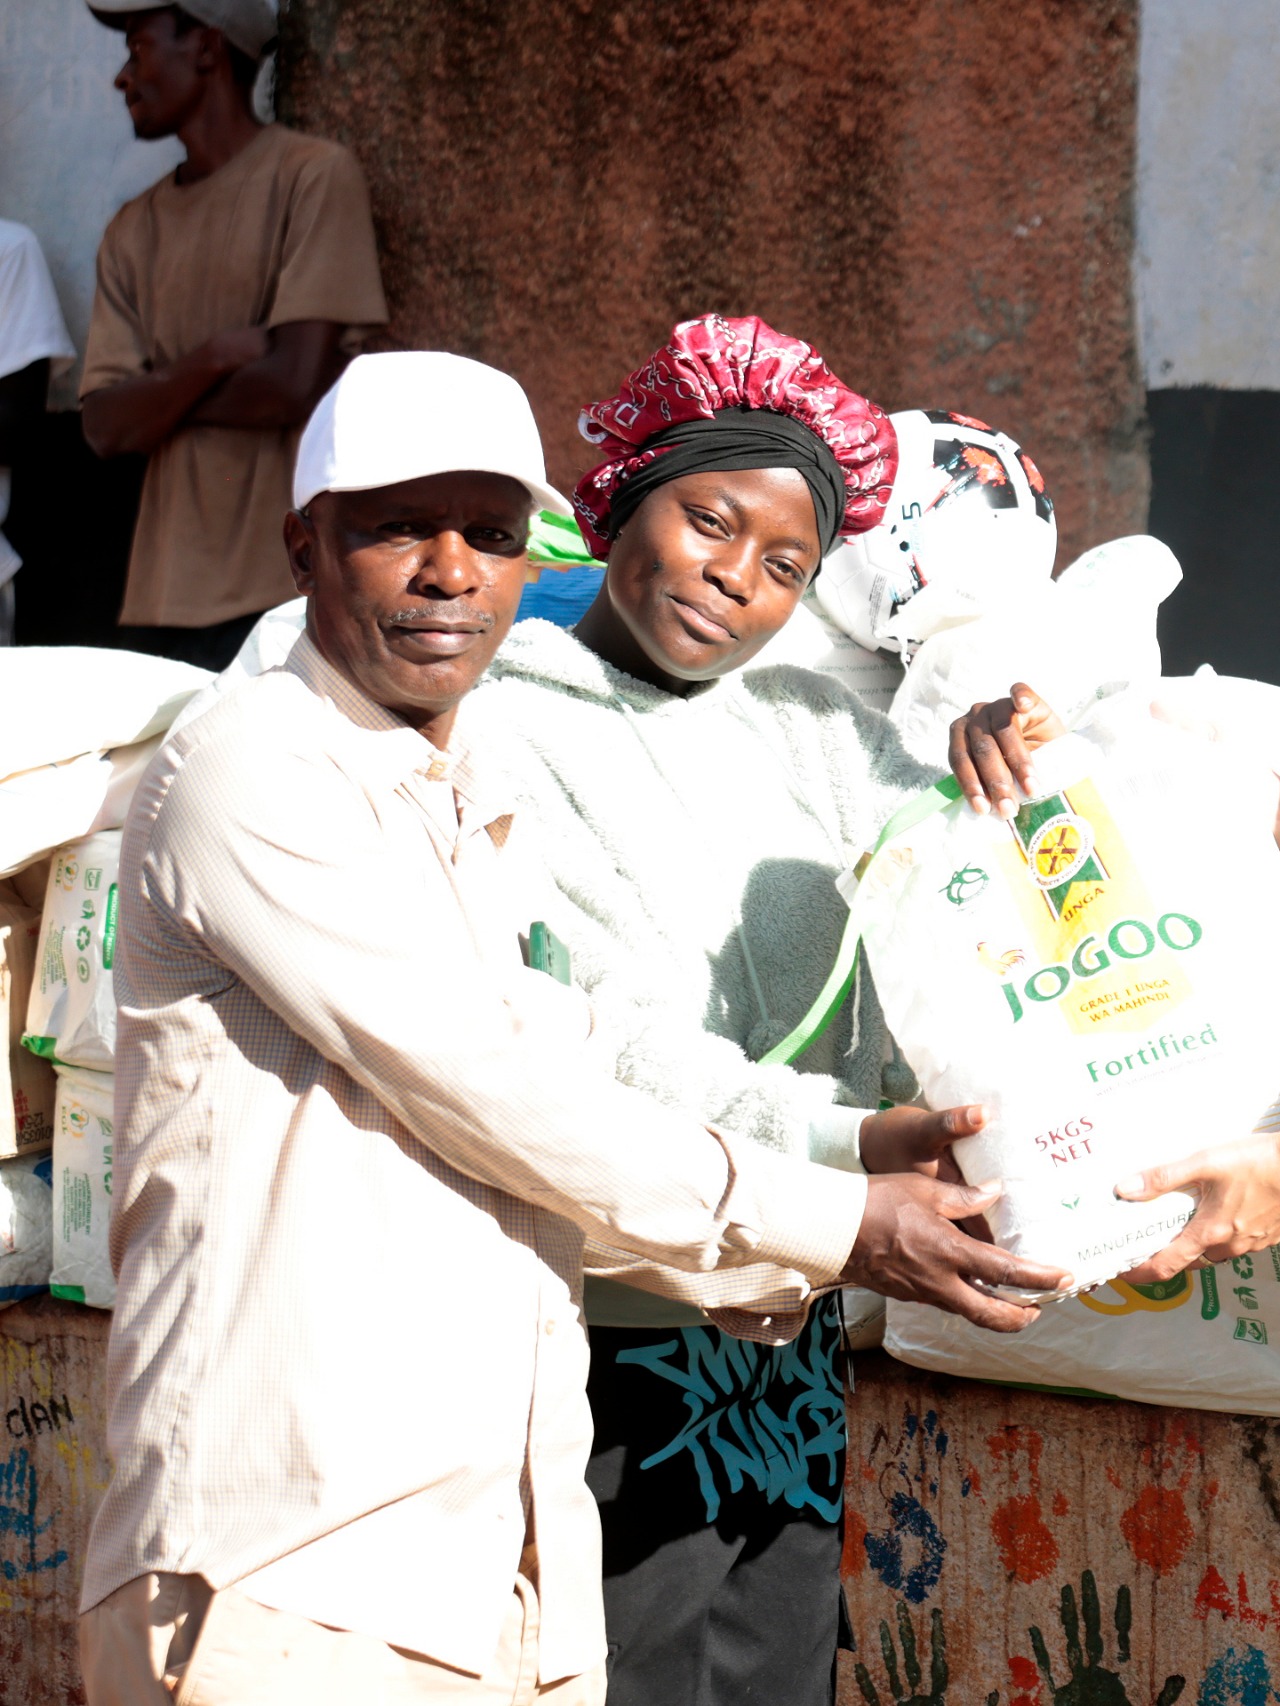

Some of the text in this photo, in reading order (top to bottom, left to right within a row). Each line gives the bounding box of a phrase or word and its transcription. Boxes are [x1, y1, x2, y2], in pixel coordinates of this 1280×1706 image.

[1063, 886, 1105, 923] UNGA
[1001, 912, 1203, 1024] JOGOO
[1080, 990, 1121, 1013] GRADE
[1135, 978, 1171, 994] UNGA
[1089, 991, 1171, 1024] WA MAHINDI
[1086, 1022, 1218, 1083] Fortified
[1034, 1115, 1094, 1152] 5KGS
[1050, 1138, 1093, 1168] NET
[1204, 1274, 1215, 1312] PRODUCT
